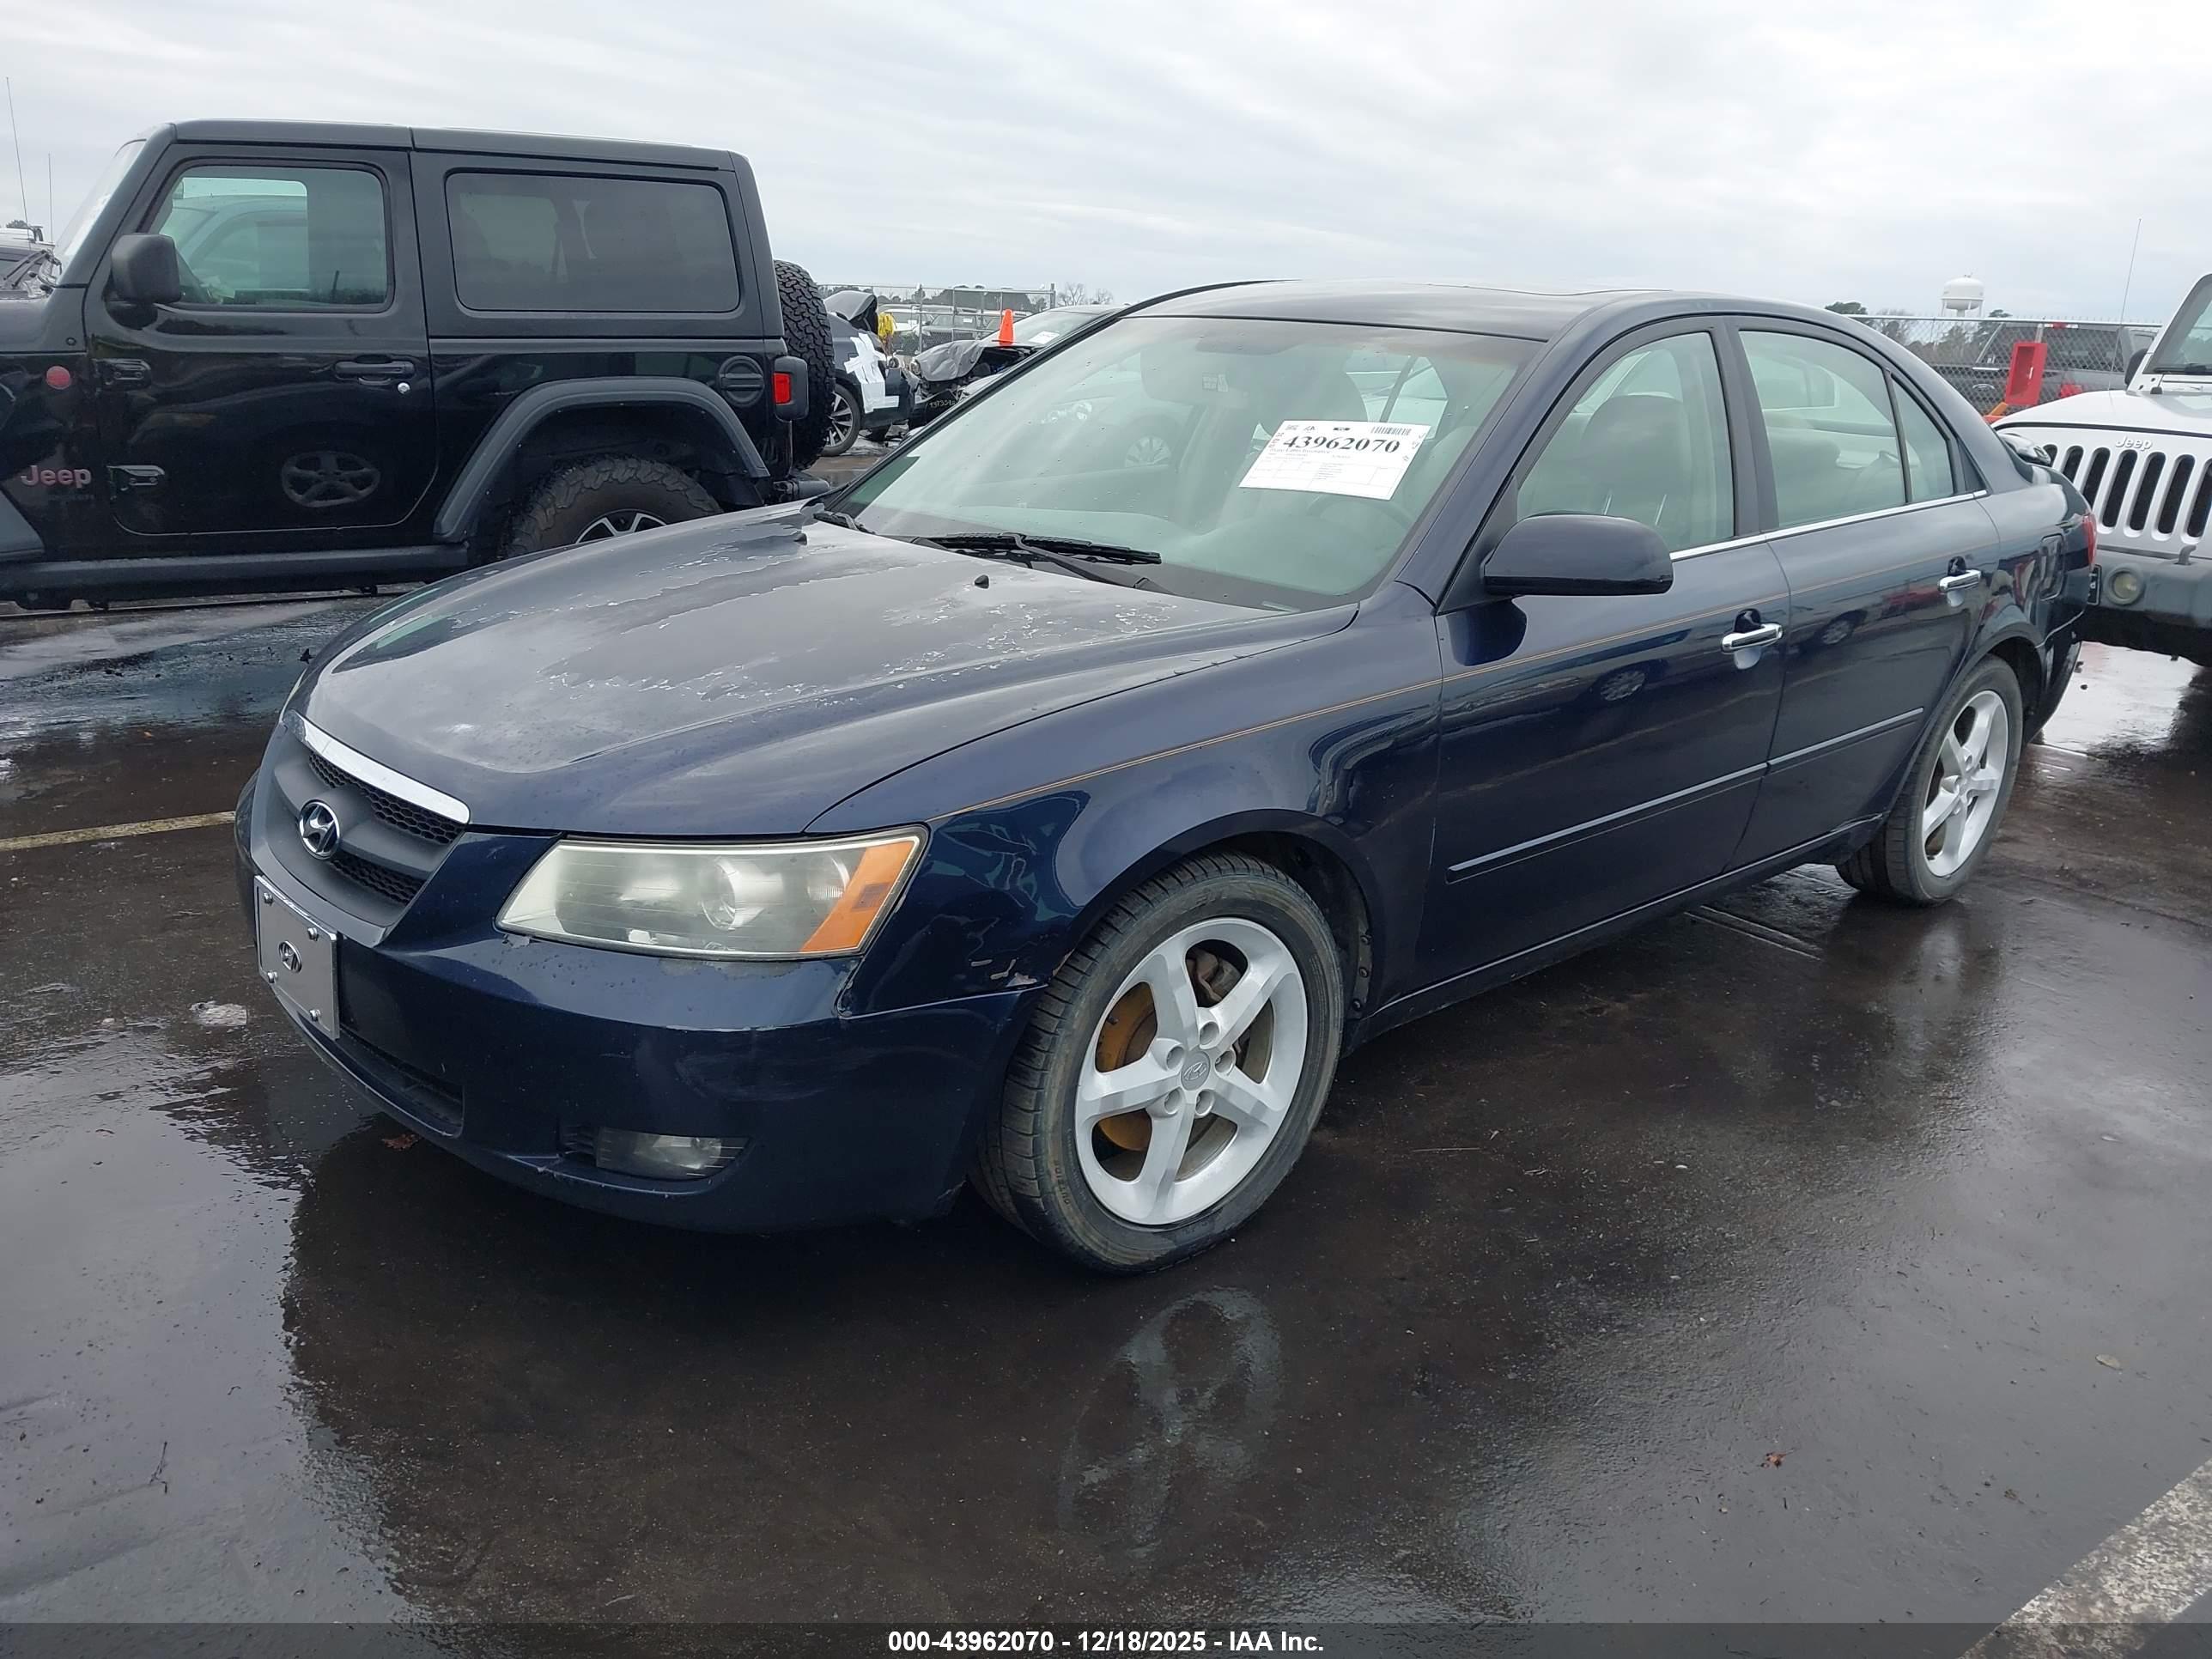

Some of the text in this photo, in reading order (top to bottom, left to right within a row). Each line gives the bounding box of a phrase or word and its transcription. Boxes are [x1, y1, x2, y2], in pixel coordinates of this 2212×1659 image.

[1283, 435, 1401, 453] 43962070
[2114, 435, 2153, 452] Jeep
[20, 465, 92, 489] Jeep
